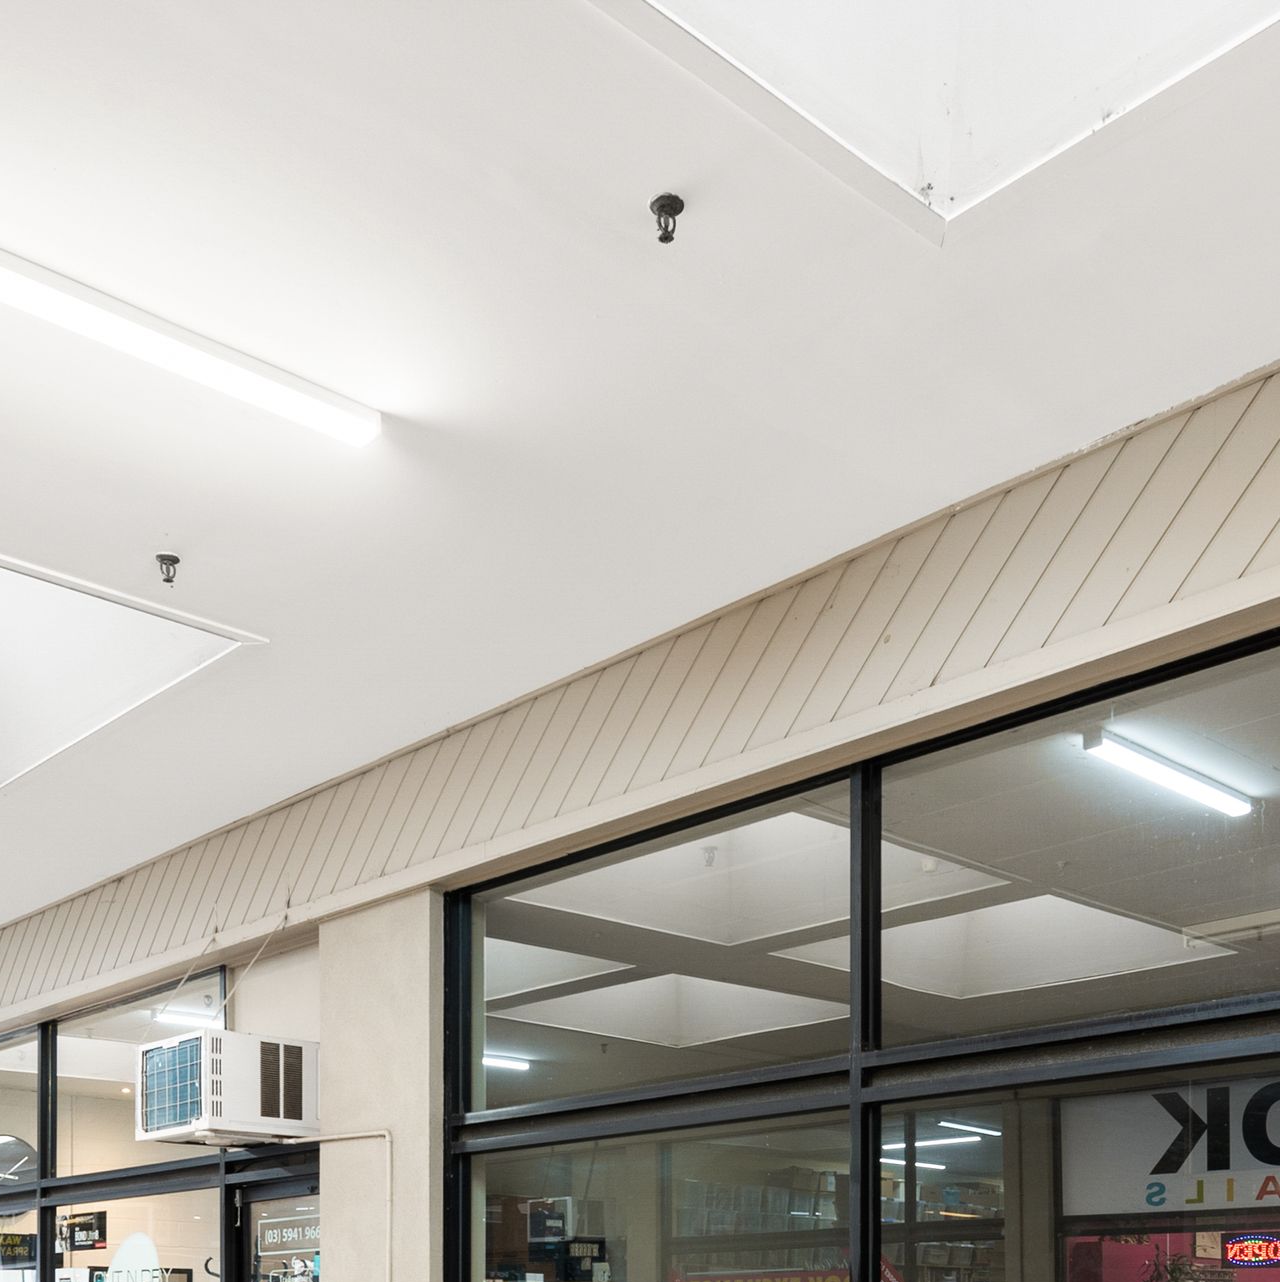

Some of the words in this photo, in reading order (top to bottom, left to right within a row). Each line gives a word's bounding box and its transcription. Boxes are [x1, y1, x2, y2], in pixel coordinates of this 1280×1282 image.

[264, 1228, 281, 1245] (03)
[282, 1227, 302, 1242] 5941
[304, 1225, 320, 1240] 966
